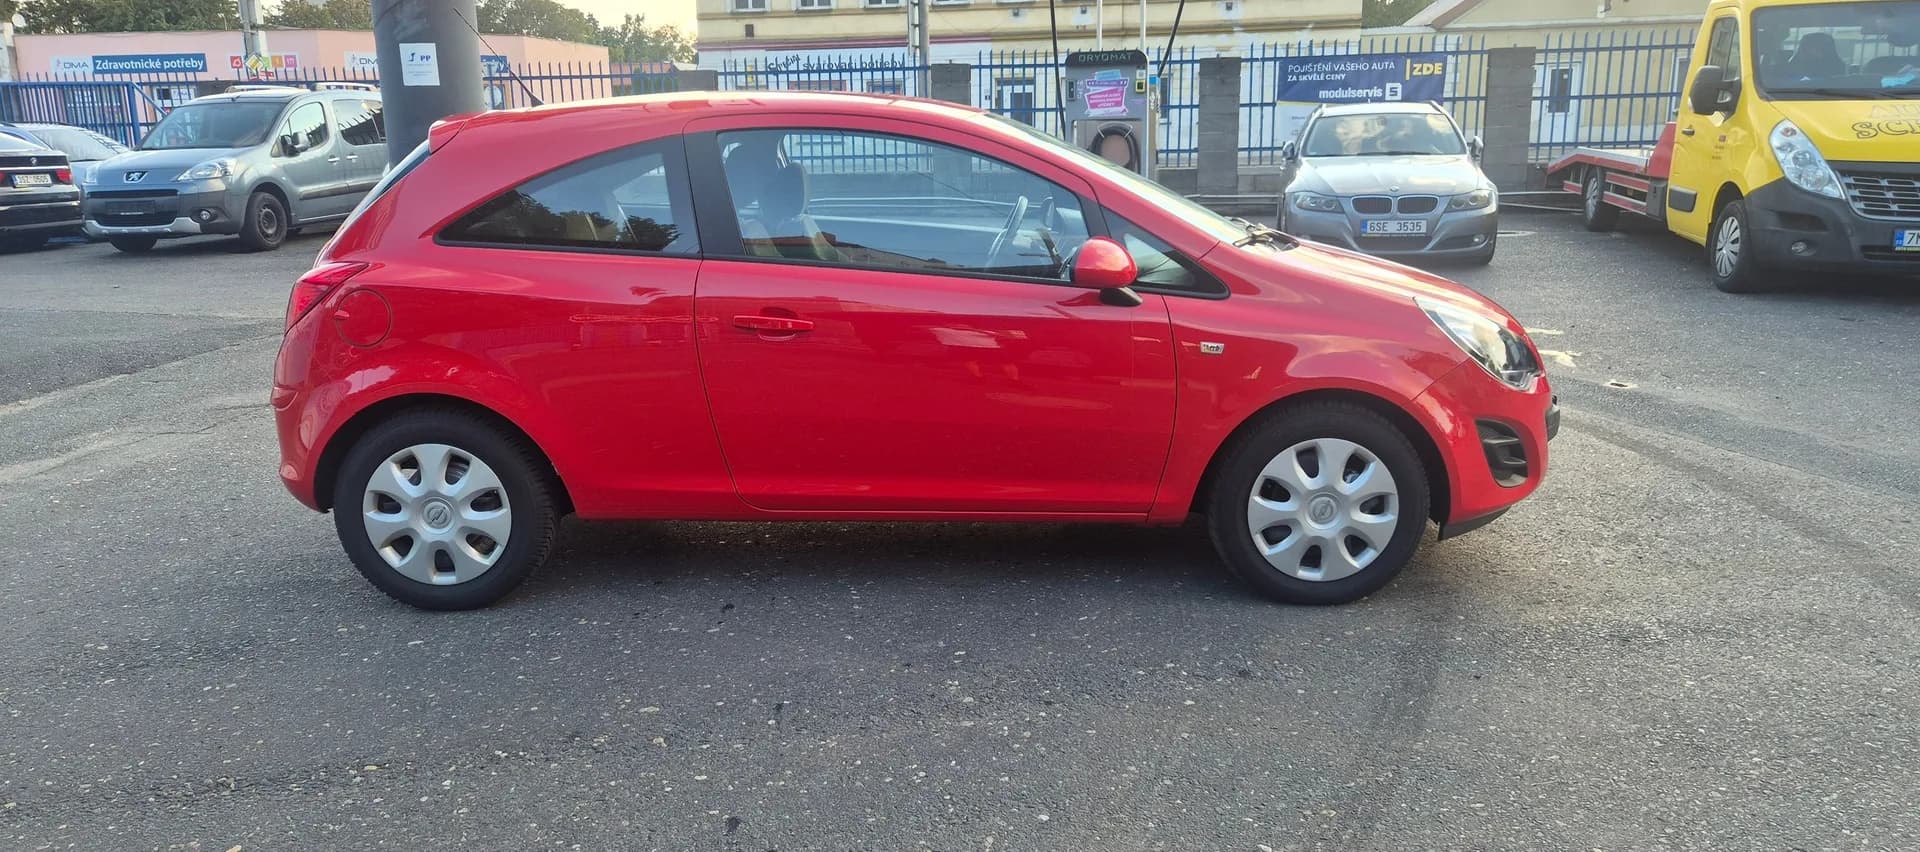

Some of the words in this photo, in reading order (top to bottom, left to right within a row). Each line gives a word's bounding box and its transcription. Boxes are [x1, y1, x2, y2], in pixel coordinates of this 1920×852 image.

[63, 61, 89, 69] DMA
[95, 59, 161, 70] Zdravotnické
[163, 58, 204, 71] potřeby
[359, 57, 377, 65] DM
[1288, 62, 1331, 73] POJIŠTĚNÍ
[1333, 61, 1369, 71] VAŠEHO
[1371, 61, 1395, 70] AUTA
[1412, 62, 1443, 75] ZDE
[1288, 74, 1297, 82] ZA
[1298, 73, 1325, 81] SKVĚLÉ
[1326, 73, 1346, 81] CENY
[1319, 86, 1383, 99] modulservis
[1369, 222, 1388, 232] 6SE
[1396, 222, 1422, 232] 3535
